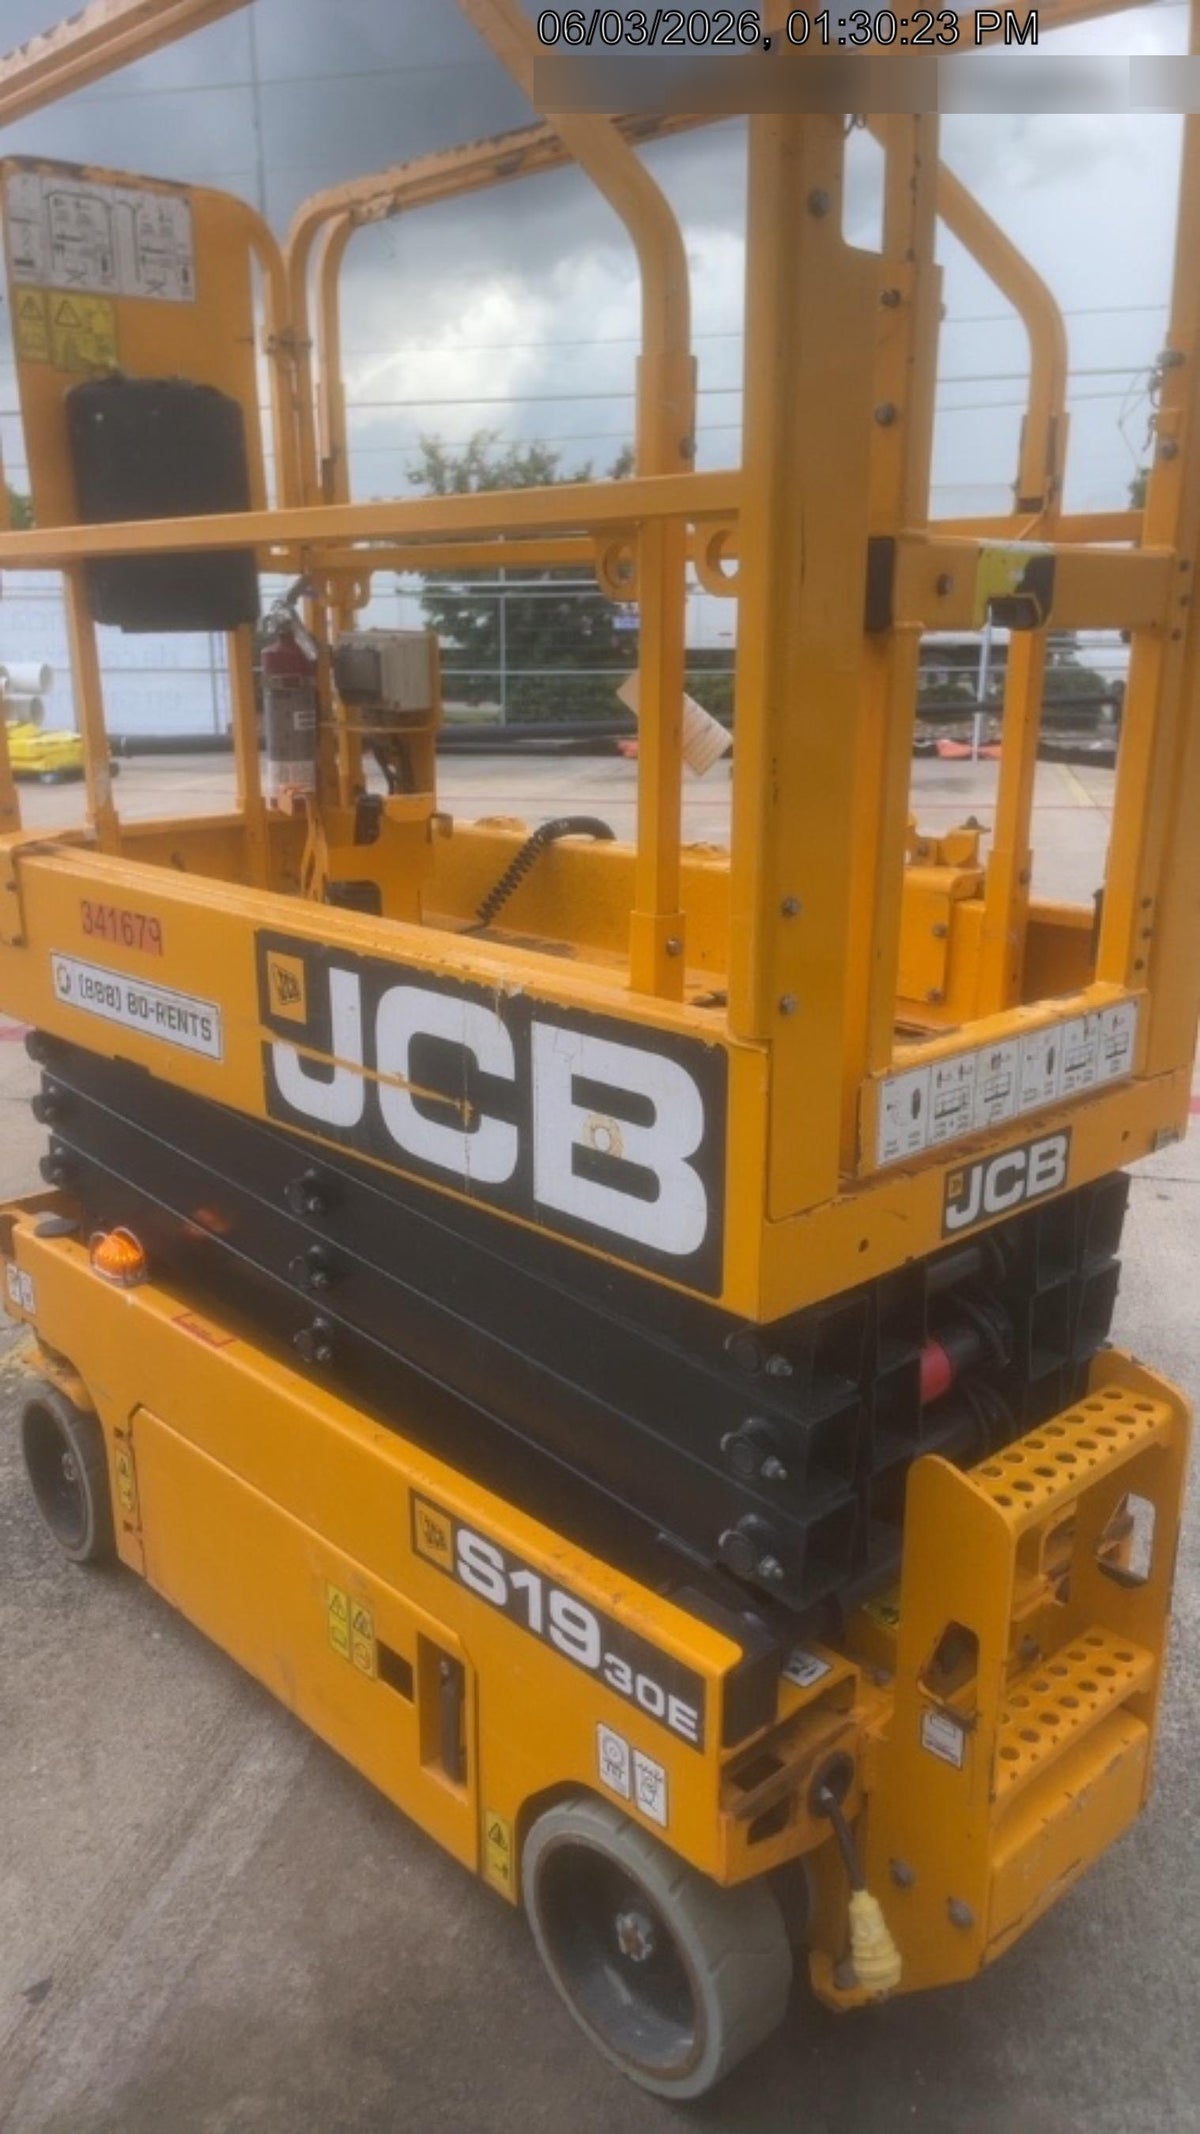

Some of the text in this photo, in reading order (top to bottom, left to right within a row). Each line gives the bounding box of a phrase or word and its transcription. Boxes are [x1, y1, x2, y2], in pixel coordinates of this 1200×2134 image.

[80, 900, 164, 957] 341679
[78, 973, 123, 1012] (888)
[271, 966, 708, 1257] JCB
[945, 1134, 1069, 1230] JCB
